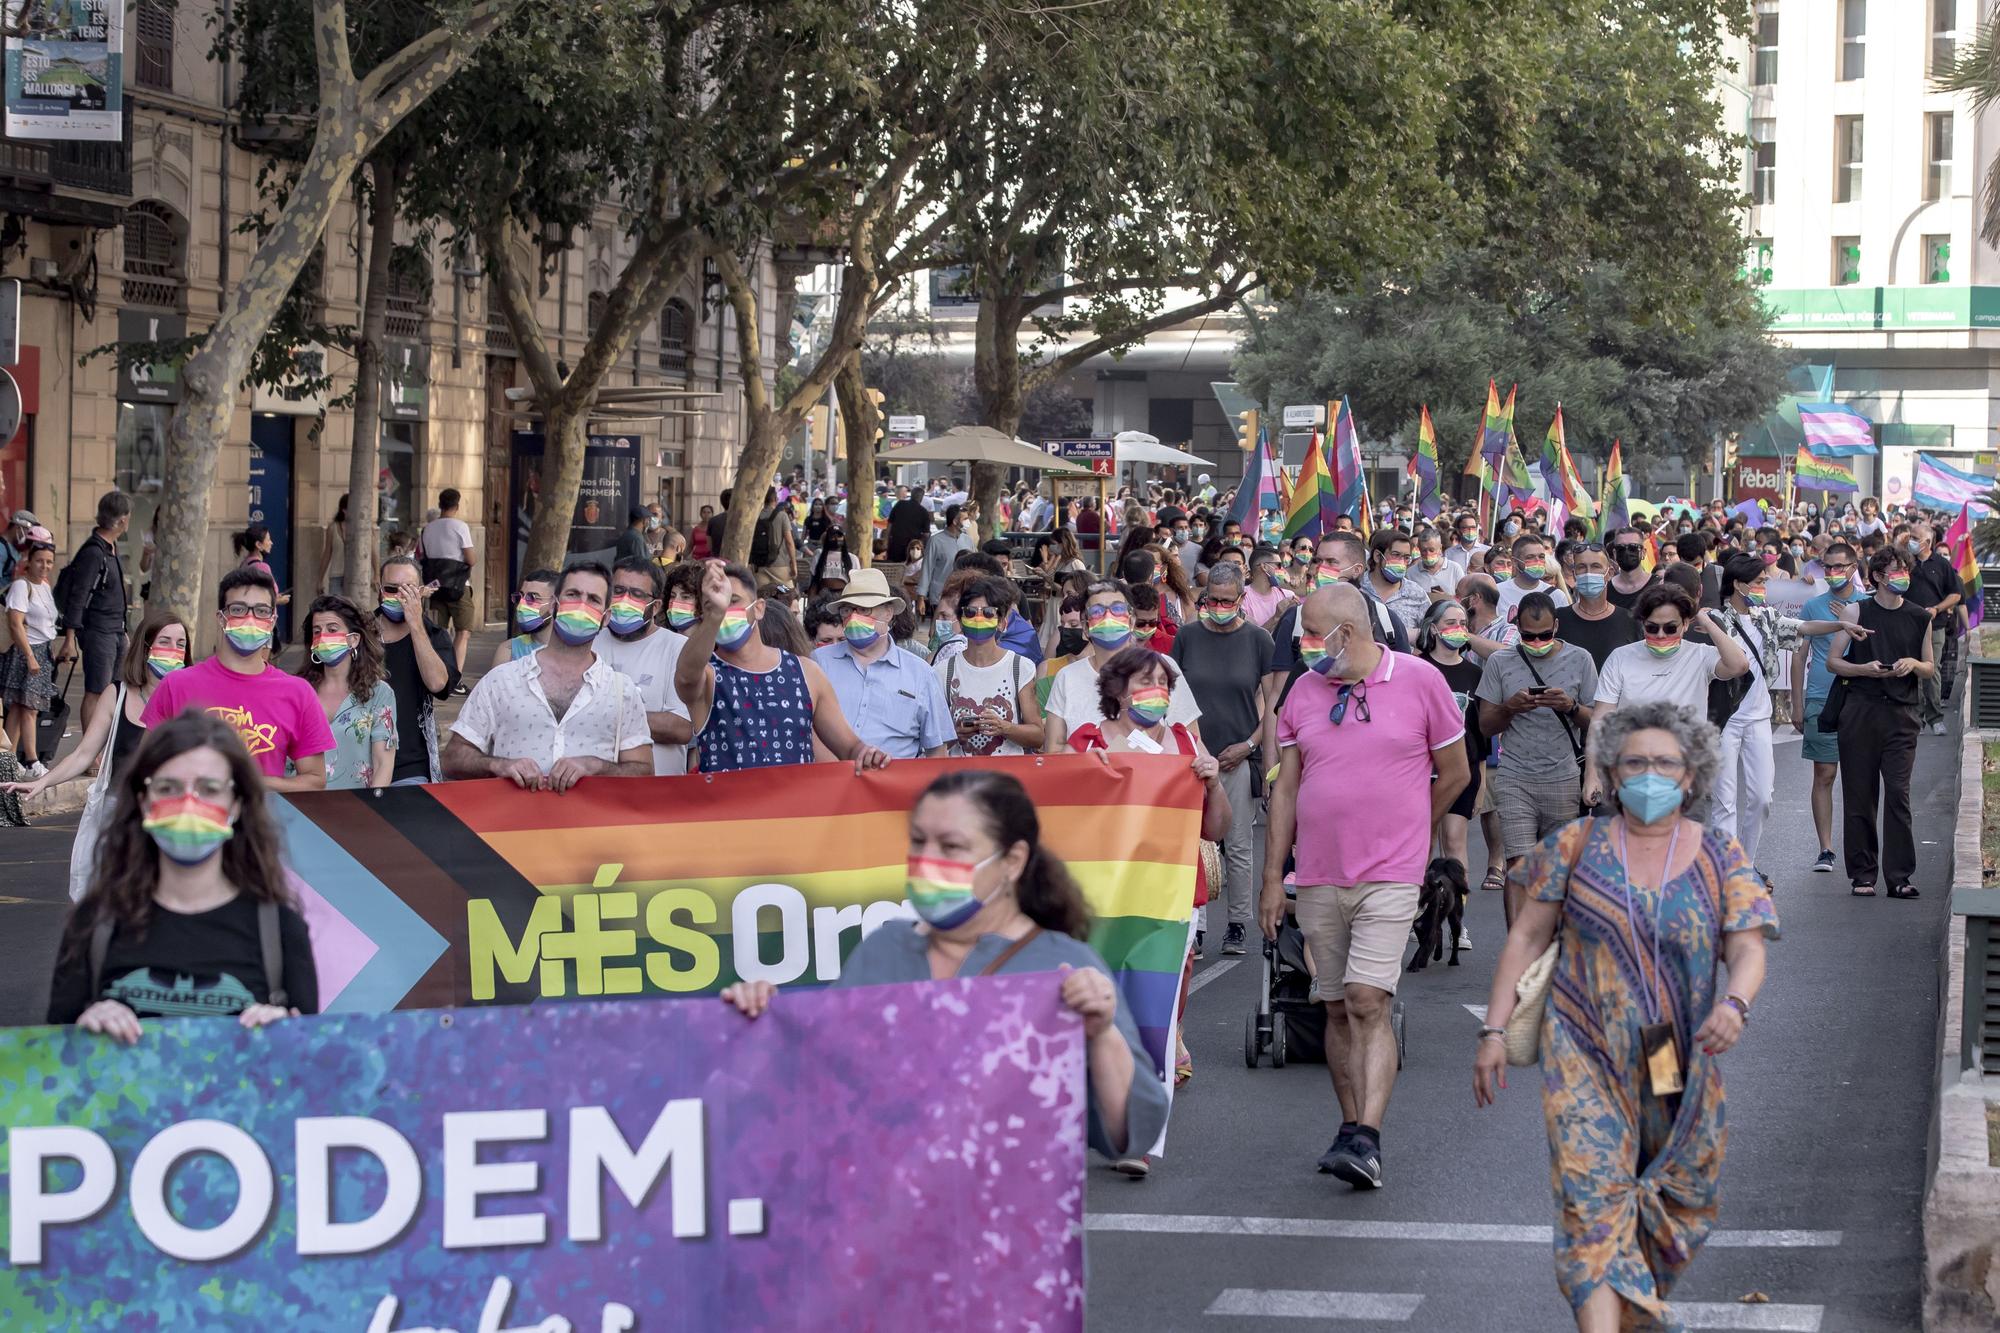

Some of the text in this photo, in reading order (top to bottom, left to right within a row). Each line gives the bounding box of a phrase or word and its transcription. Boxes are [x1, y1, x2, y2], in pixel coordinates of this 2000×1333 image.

[80, 0, 104, 11] ESTO
[93, 13, 105, 25] ES
[78, 26, 105, 38] TENIS
[26, 55, 50, 68] ESTO
[24, 70, 38, 81] ES
[1047, 442, 1060, 455] P
[1066, 449, 1111, 457] Avingudes
[119, 986, 197, 1004] GOTHAM
[9, 1097, 763, 1265] PODEM.
